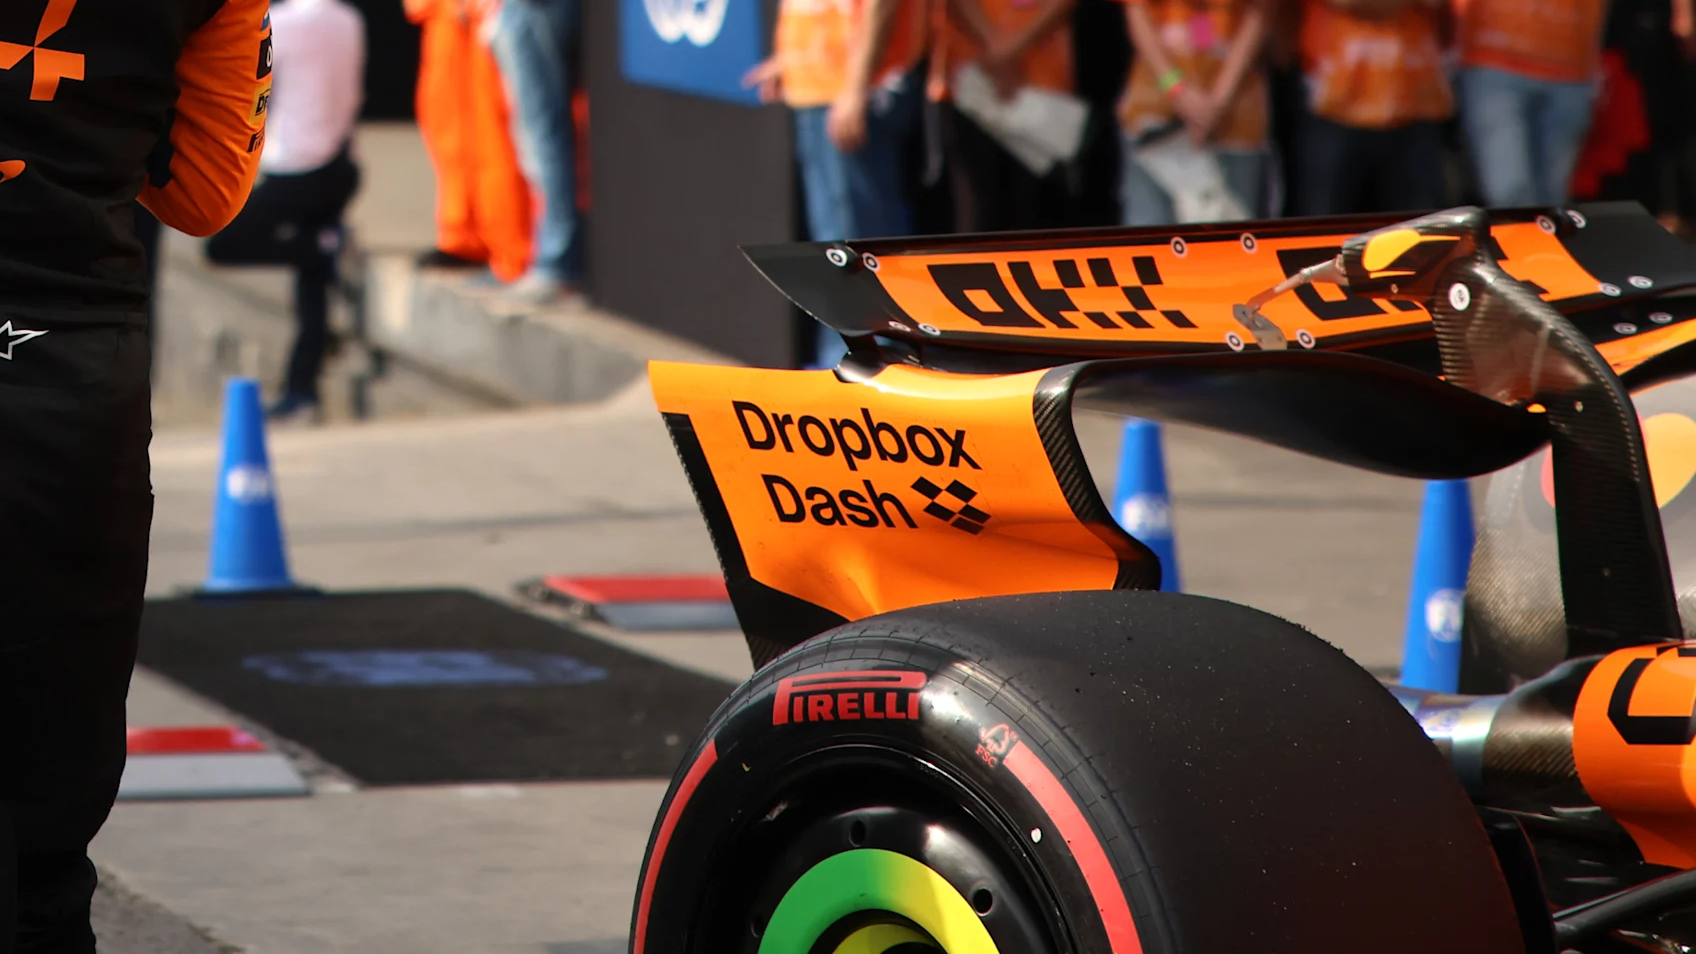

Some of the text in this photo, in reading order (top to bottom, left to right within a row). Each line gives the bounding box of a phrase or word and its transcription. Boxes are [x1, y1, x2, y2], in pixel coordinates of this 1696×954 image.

[732, 400, 983, 471] Dropbox
[761, 473, 919, 529] Dash
[772, 670, 928, 726] PIRELLI
[974, 743, 999, 768] FSC
